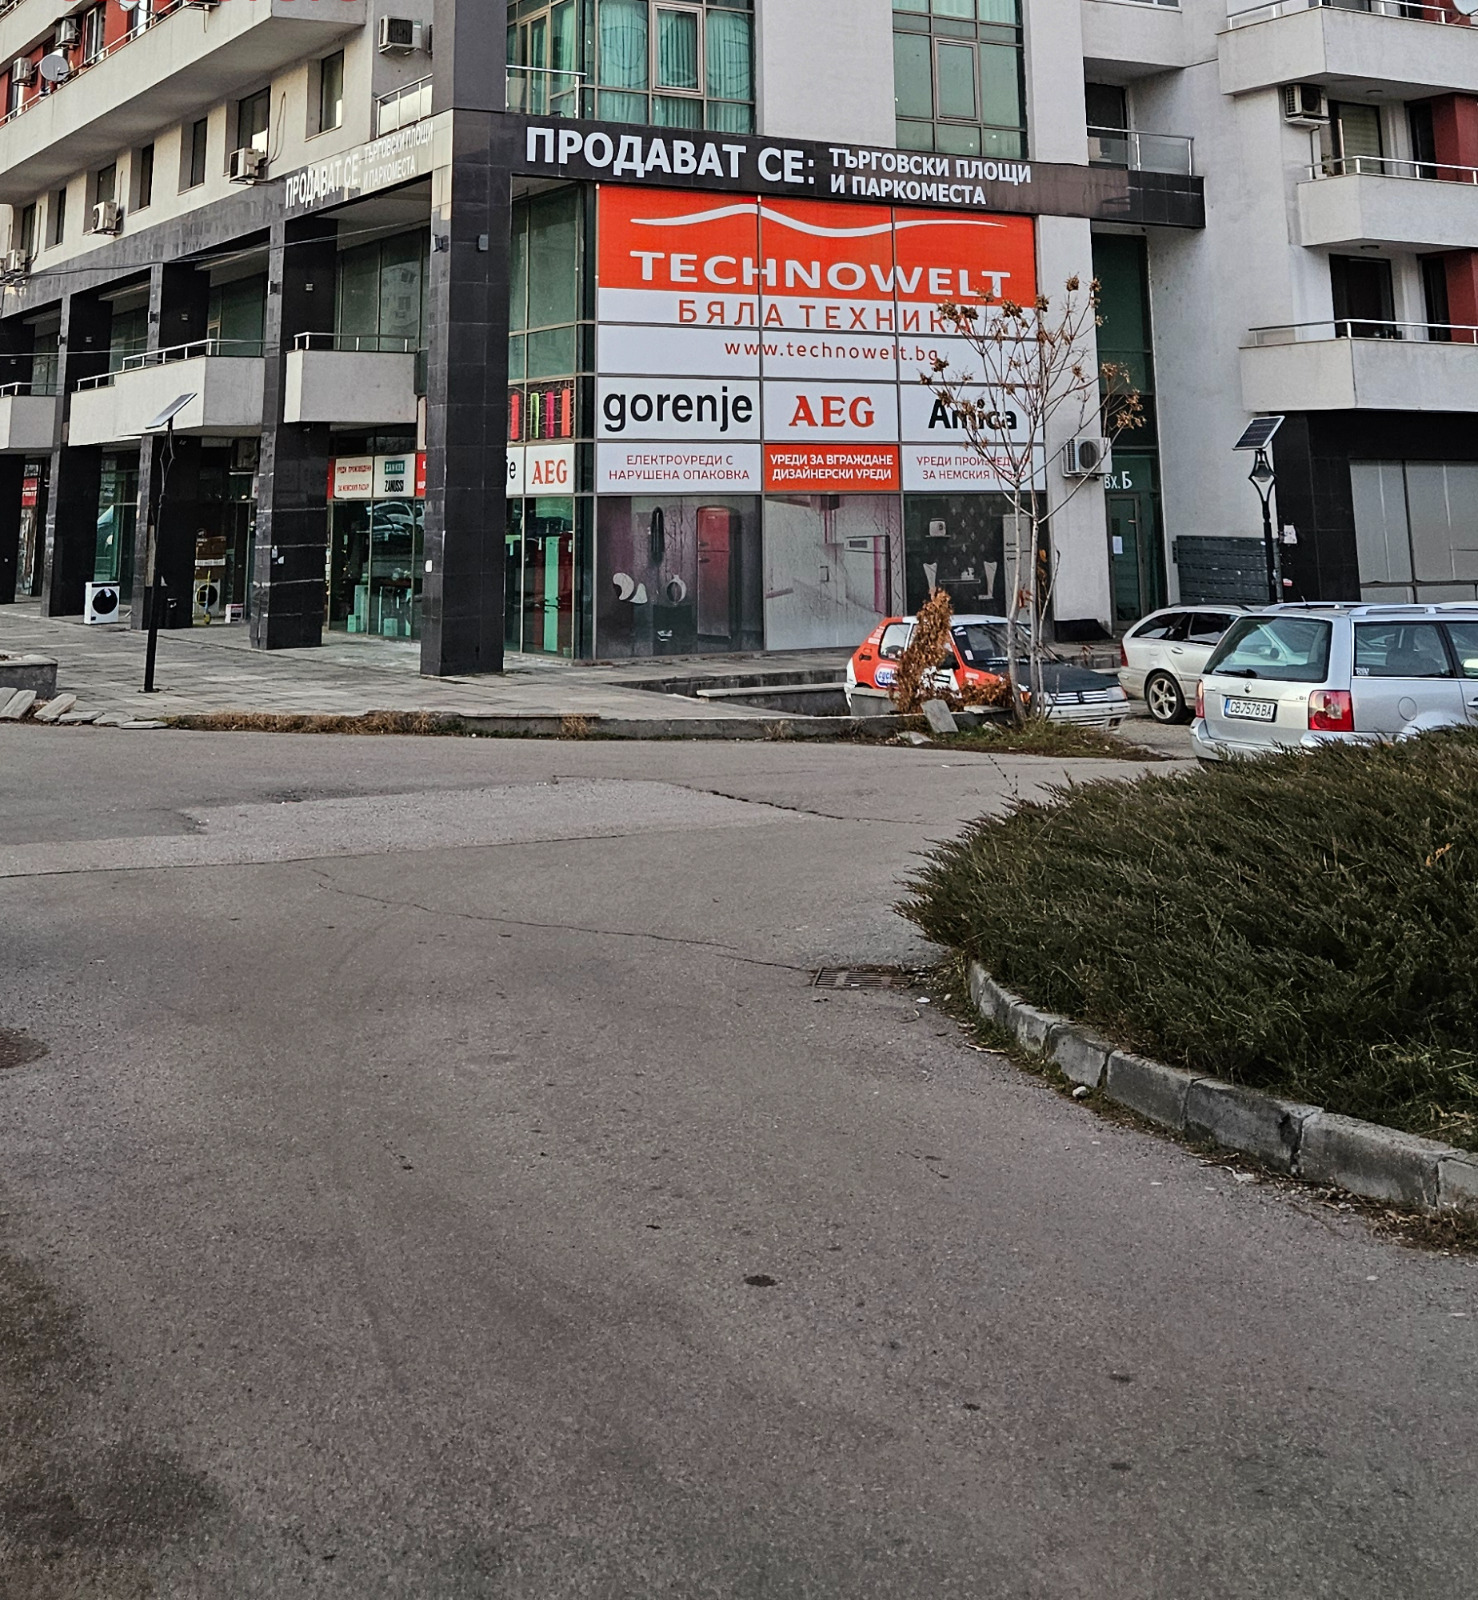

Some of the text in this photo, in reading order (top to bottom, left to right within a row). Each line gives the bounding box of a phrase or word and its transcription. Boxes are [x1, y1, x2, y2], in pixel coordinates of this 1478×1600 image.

[526, 126, 815, 184] ПРОДАВАТ СЕ:
[829, 147, 1032, 186] ТЪРГОВСКИ ПЛОЩИ
[285, 159, 342, 209] ПРОДАВАТ
[369, 154, 416, 188] ПАРКОМЕСТА
[830, 174, 987, 205] И ПАРКОМЕСТА
[629, 250, 1011, 299] TECHNOWELT
[678, 299, 973, 334] БЯЛА ТЕХНИКА
[724, 341, 939, 366] www.technowelt.bg
[603, 386, 753, 432] gorenje
[788, 395, 875, 428] AEG
[928, 398, 1018, 430] Amica
[531, 459, 568, 485] AEG
[608, 469, 750, 480] НАРУШЕНА ОПАКОВКА
[626, 454, 734, 467] ЕЛЕКТРОУРЕДИ С
[770, 454, 894, 467] УРЕДИ ЗА ВГРАЖДАНЕ
[772, 466, 892, 481] ДИЗАЙНЕРСКИ УРЕДИ
[916, 456, 952, 467] УРЕДИ
[922, 470, 936, 480] ЗА
[938, 470, 990, 480] НЕМСКИЯ
